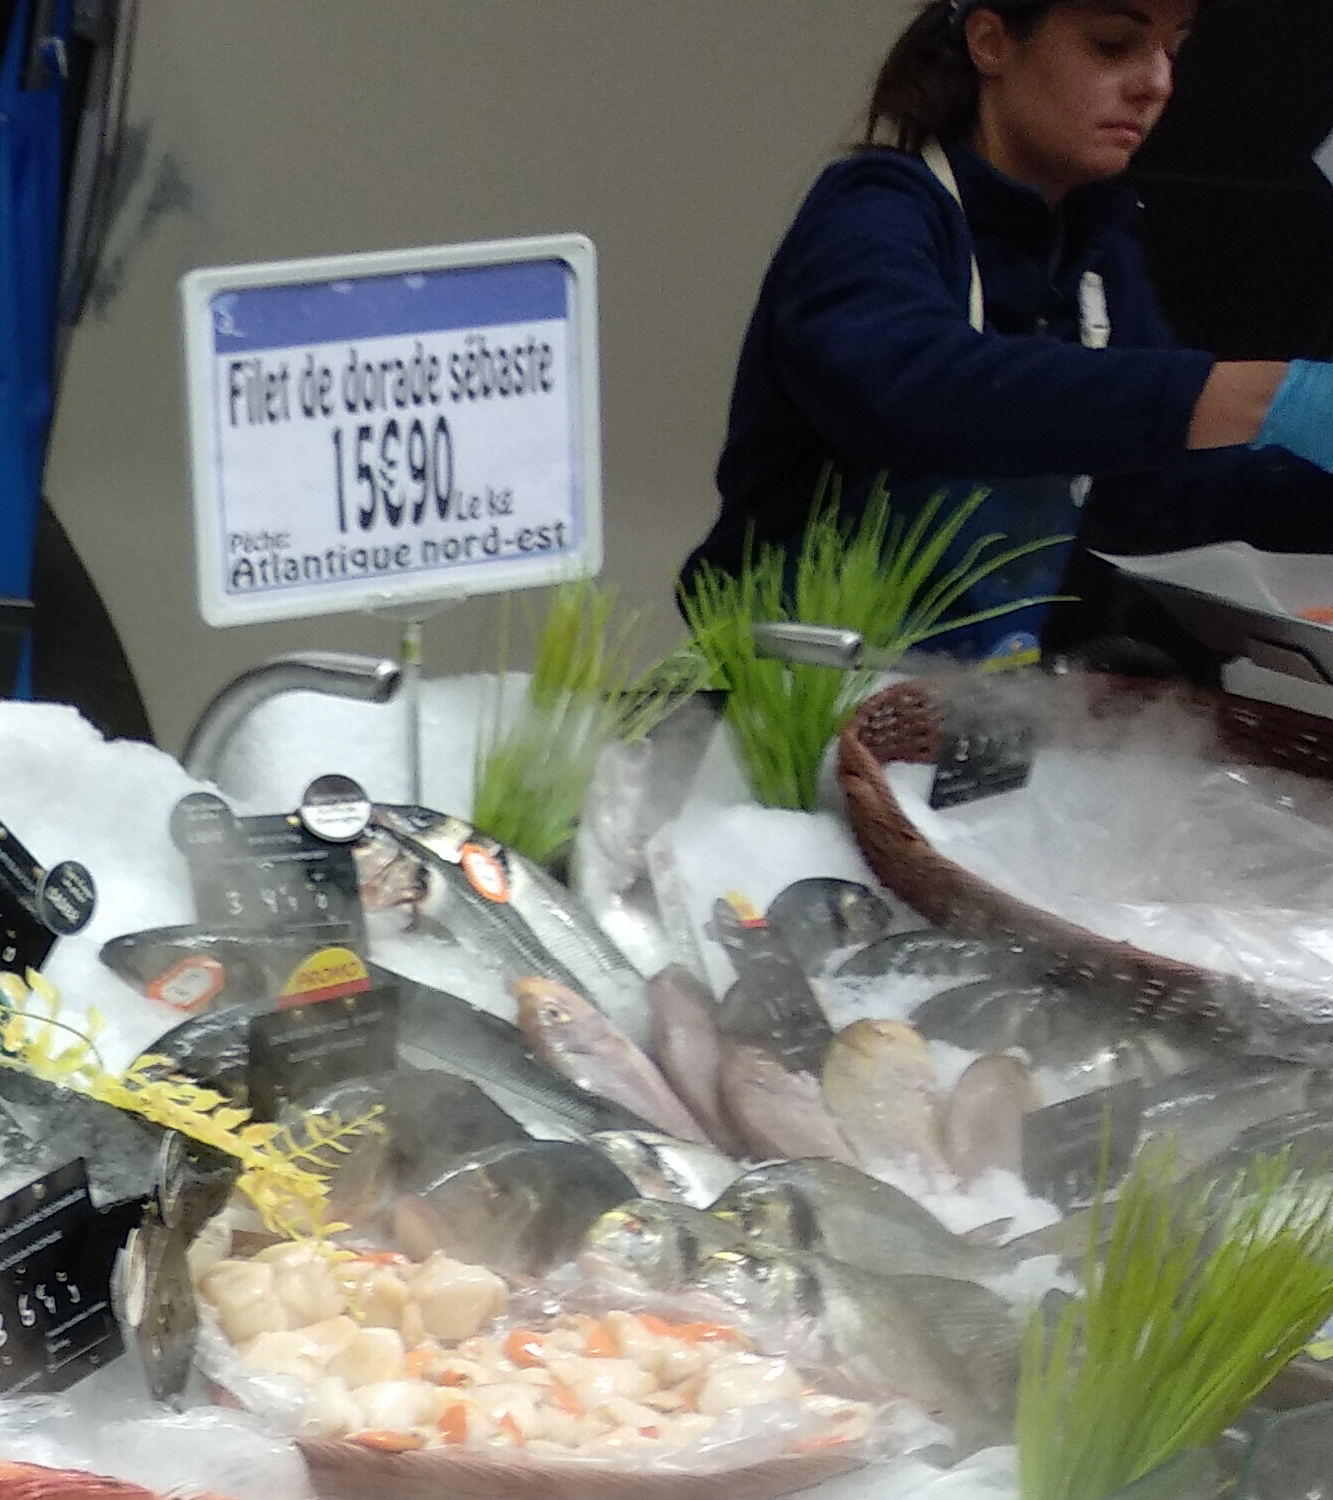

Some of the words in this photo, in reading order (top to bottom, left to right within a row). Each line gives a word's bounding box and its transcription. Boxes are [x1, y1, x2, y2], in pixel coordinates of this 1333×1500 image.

[229, 358, 290, 428] Filet
[301, 353, 333, 419] de
[342, 340, 440, 414] dorade
[231, 542, 411, 588] Atlantique
[420, 521, 566, 564] nord-est
